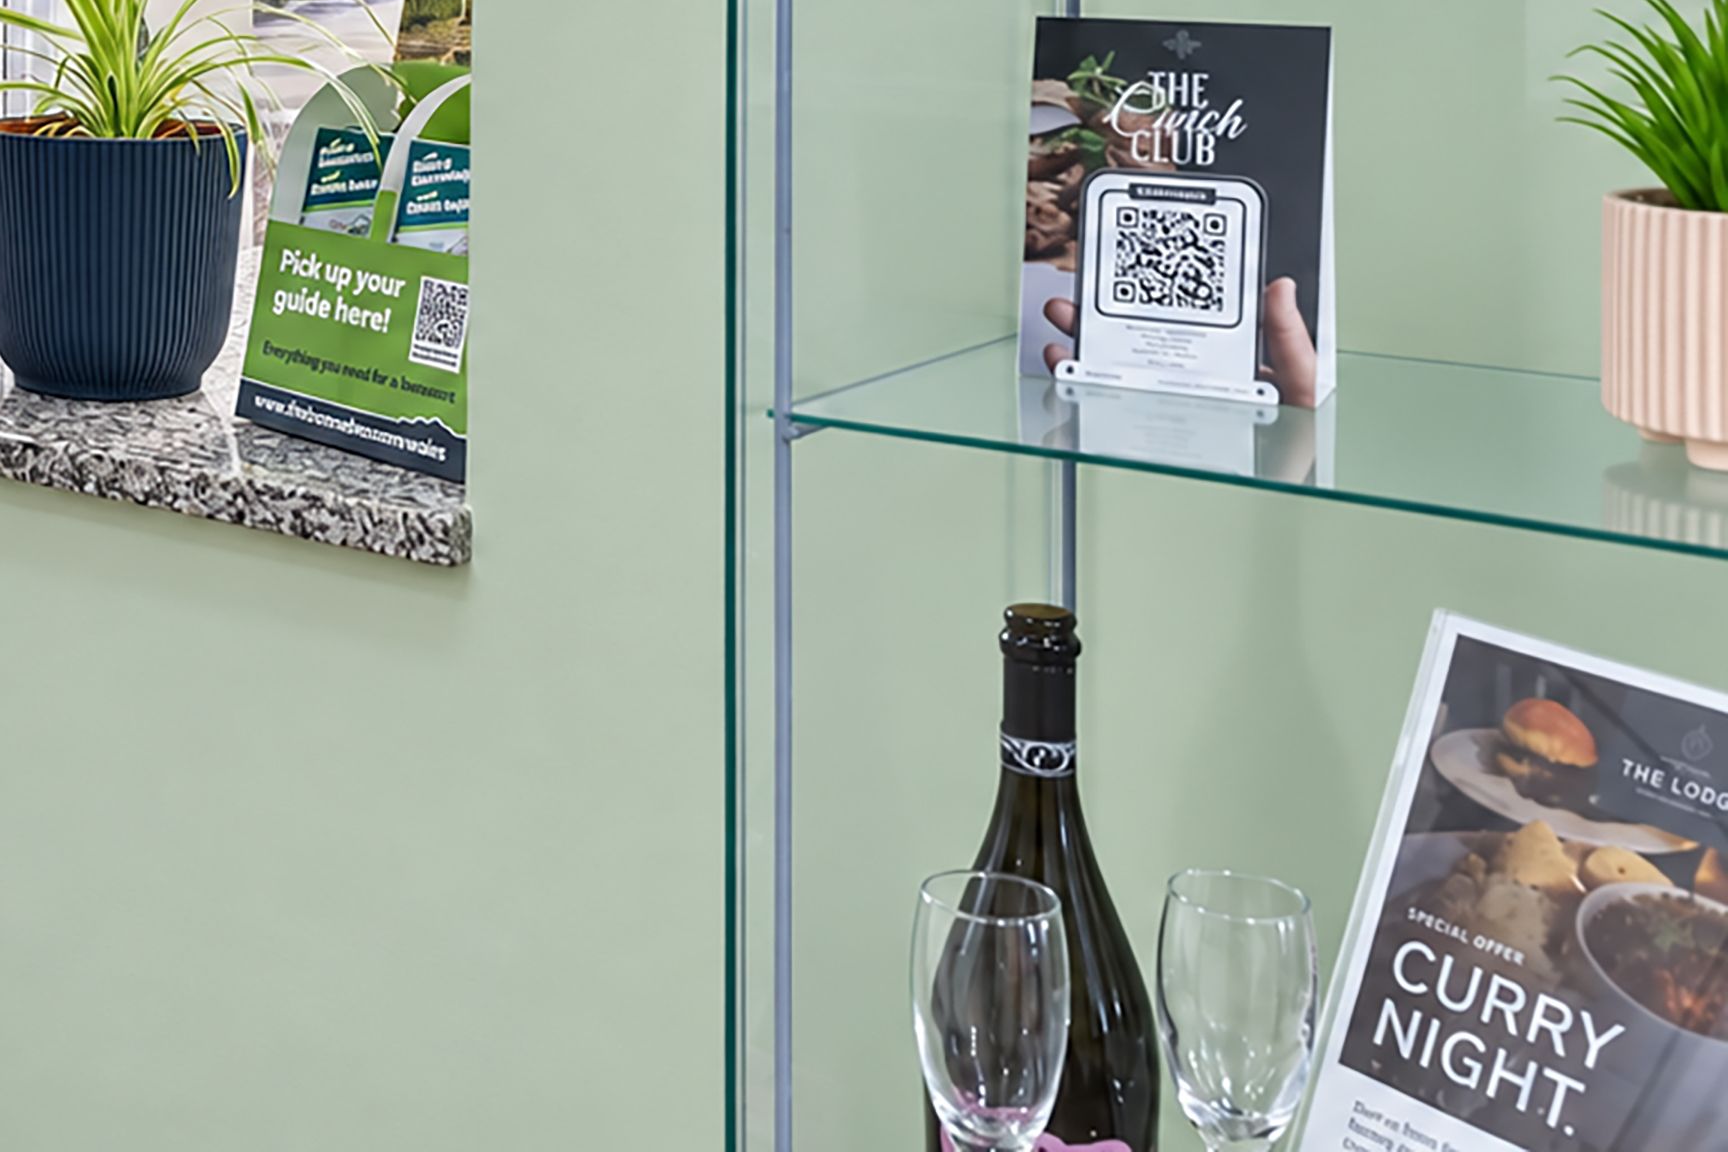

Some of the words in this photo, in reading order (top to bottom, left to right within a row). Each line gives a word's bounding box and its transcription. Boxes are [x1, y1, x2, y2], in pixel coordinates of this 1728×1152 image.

[1147, 71, 1209, 109] THE
[1131, 129, 1216, 165] CLUB
[279, 249, 322, 280] Pick
[325, 263, 352, 290] up
[352, 269, 406, 297] your
[272, 287, 331, 318] guide
[334, 296, 391, 333] here!
[262, 339, 320, 373] Everything
[319, 359, 341, 374] you
[371, 368, 388, 386] for
[389, 378, 398, 389] a
[1622, 758, 1665, 788] THE
[1406, 906, 1471, 948] SPECIAL
[1472, 933, 1526, 966] OFFER
[1391, 939, 1626, 1070] CURRY
[1372, 997, 1587, 1137] NIGHT.
